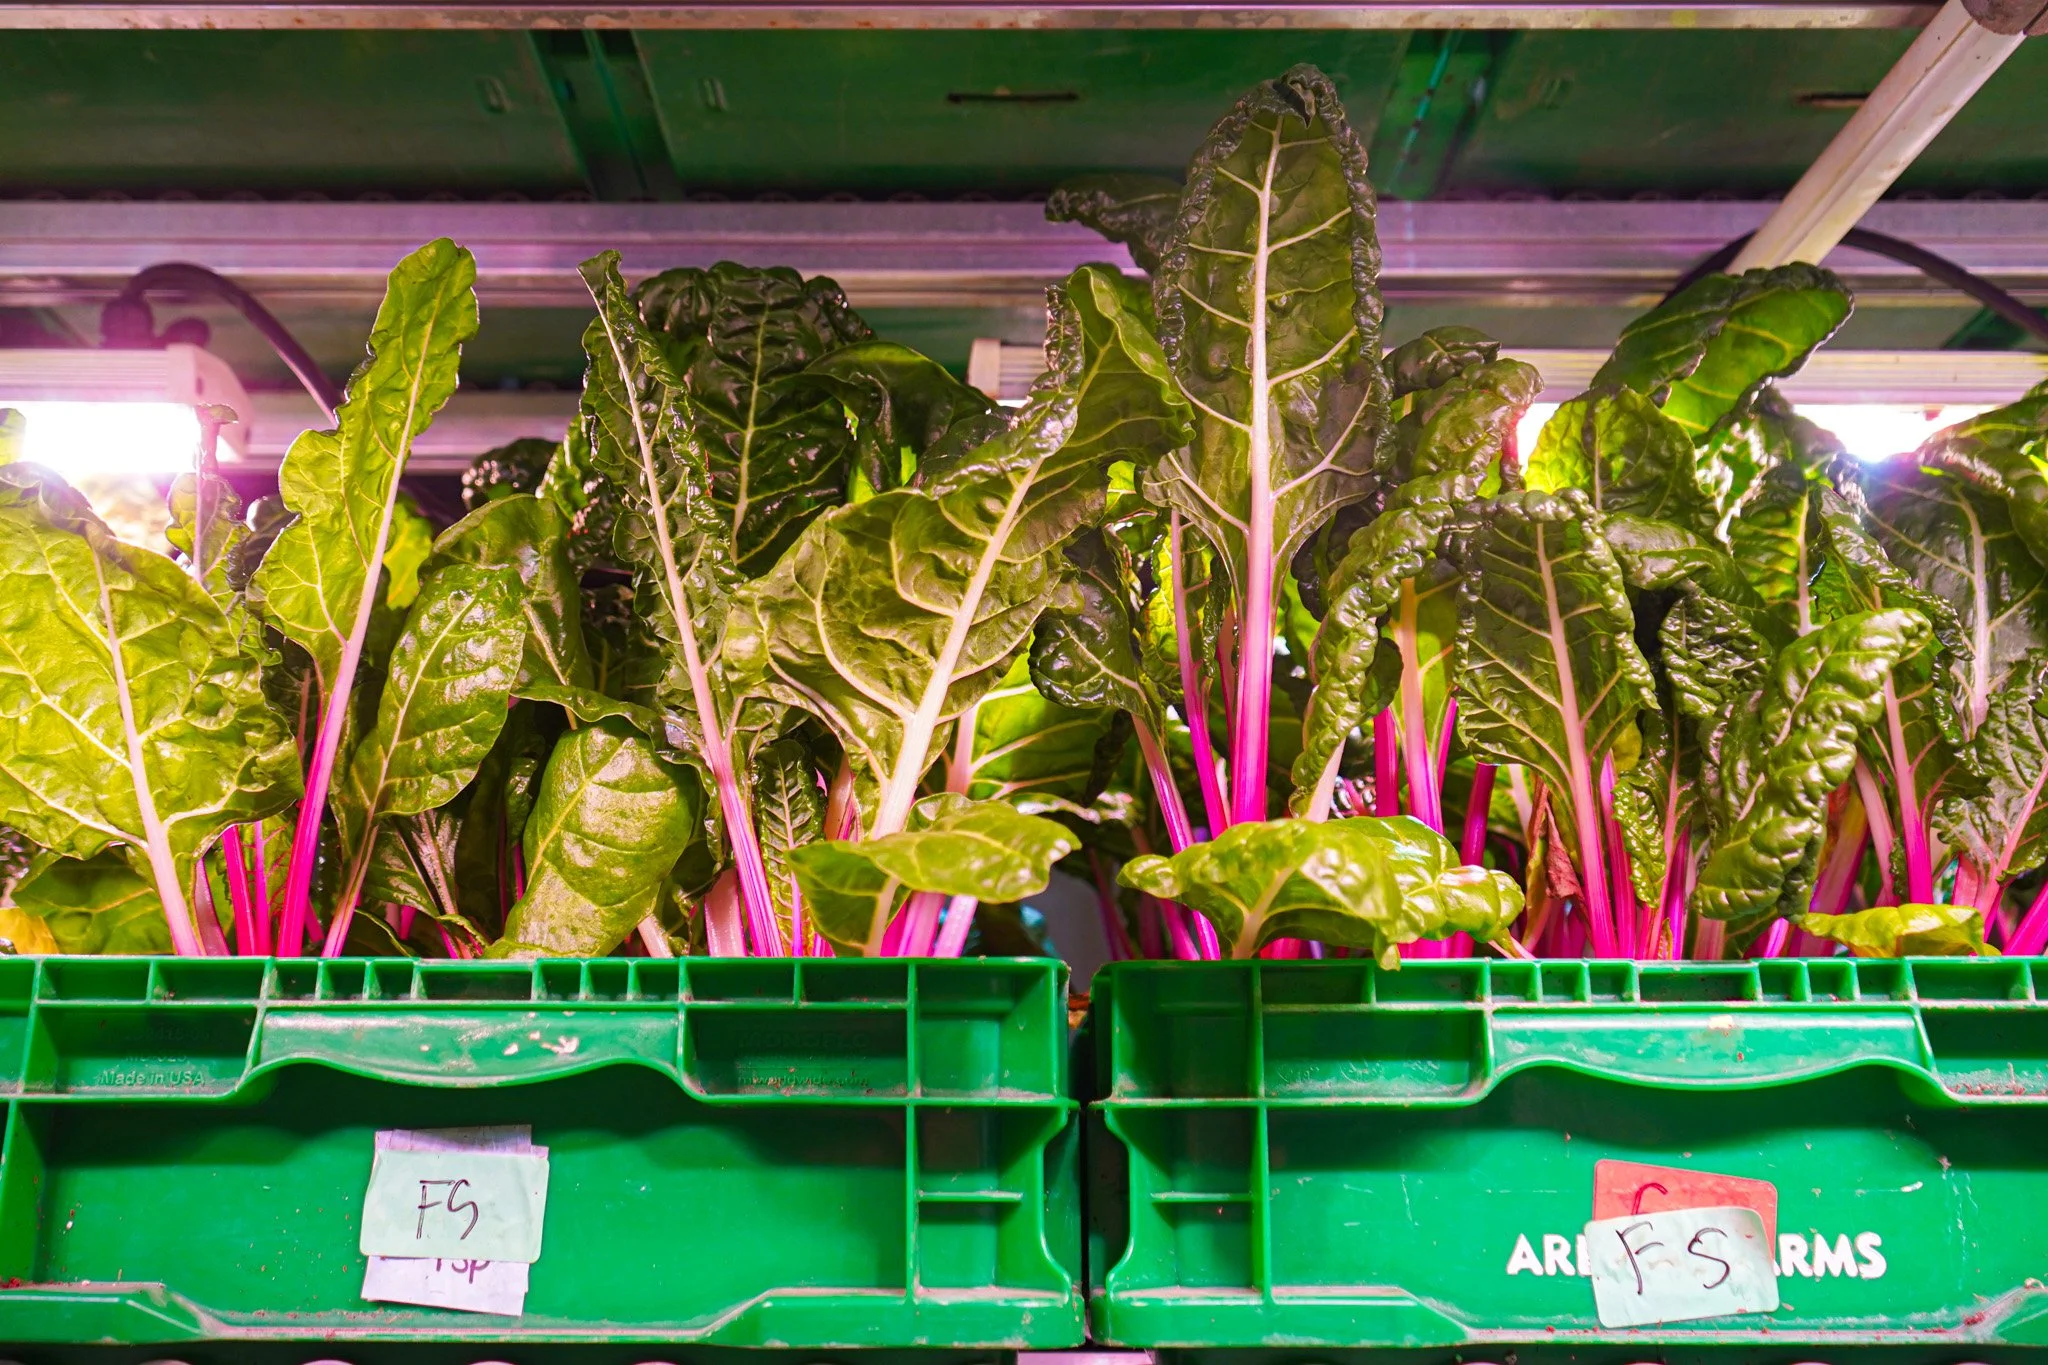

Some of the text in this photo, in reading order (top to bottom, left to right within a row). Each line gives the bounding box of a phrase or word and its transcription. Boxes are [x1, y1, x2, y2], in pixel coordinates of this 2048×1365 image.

[101, 1070, 206, 1085] Made in USA
[416, 1178, 479, 1240] FS
[1773, 1231, 1887, 1279] RMS
